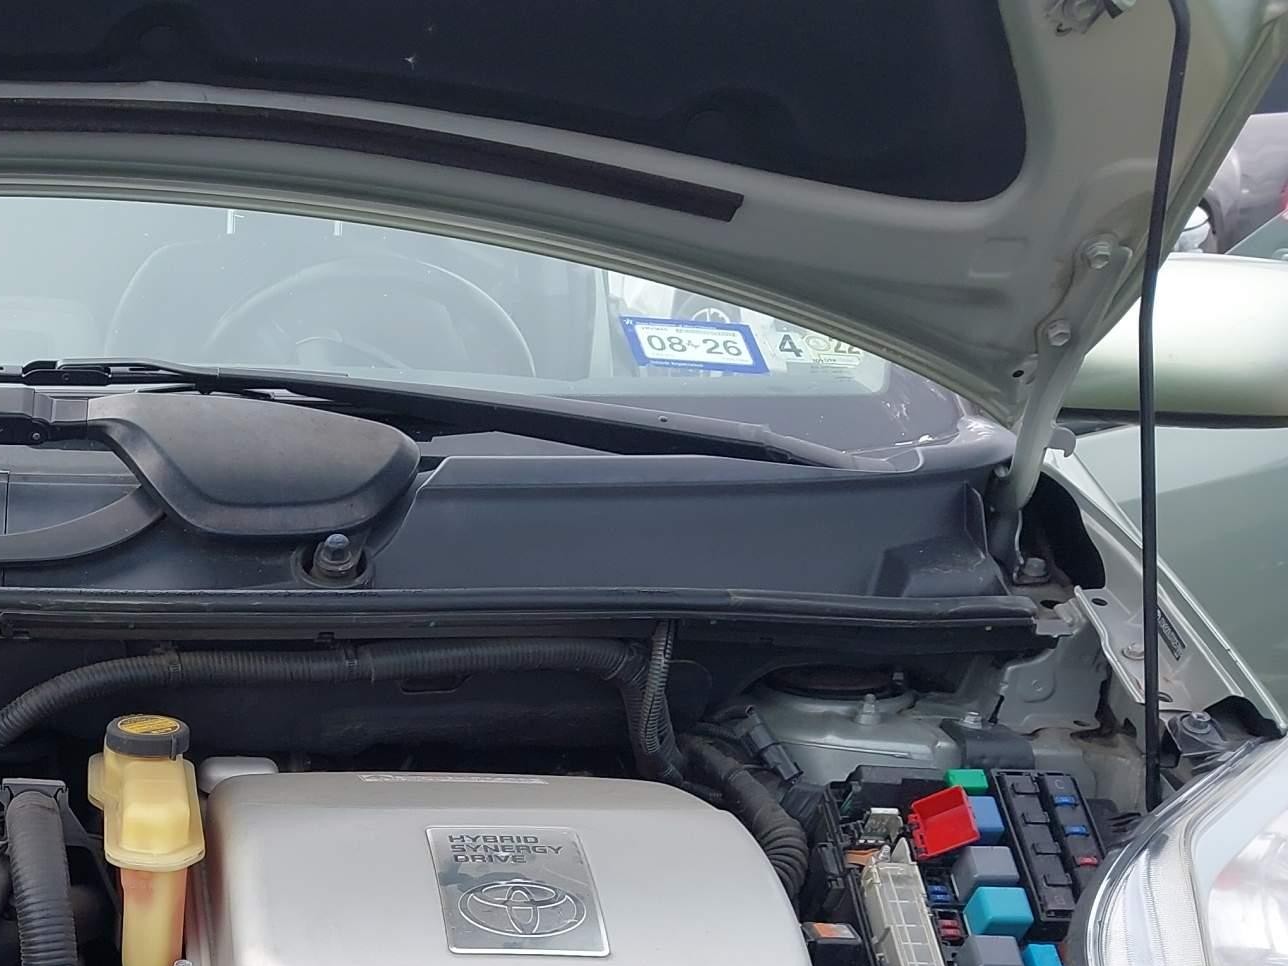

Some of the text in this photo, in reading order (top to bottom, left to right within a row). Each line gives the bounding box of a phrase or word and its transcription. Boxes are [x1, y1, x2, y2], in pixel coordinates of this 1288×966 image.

[647, 335, 742, 357] 08 26
[778, 333, 803, 357] 4
[448, 834, 539, 844] HYBRID
[451, 844, 563, 855] SYNERGY
[454, 854, 527, 864] DRIVE
